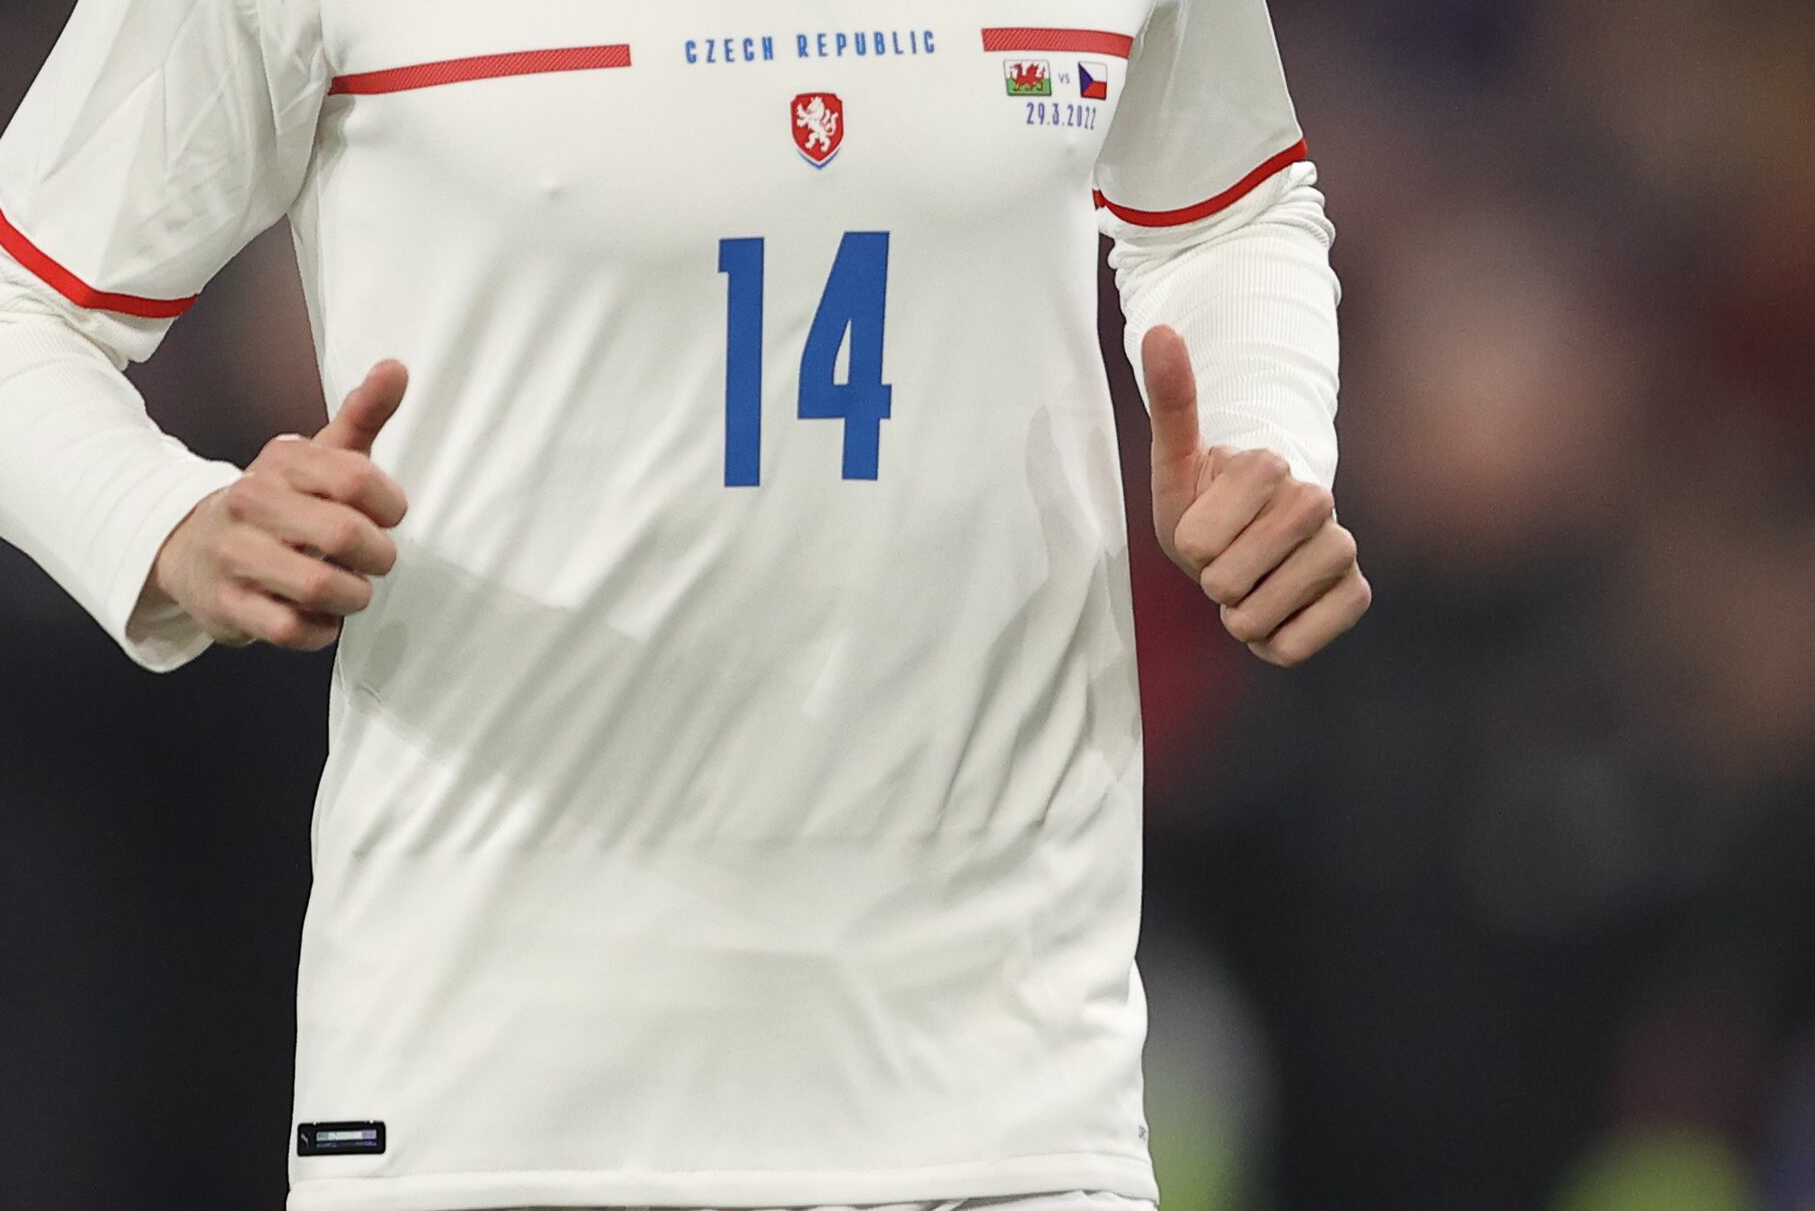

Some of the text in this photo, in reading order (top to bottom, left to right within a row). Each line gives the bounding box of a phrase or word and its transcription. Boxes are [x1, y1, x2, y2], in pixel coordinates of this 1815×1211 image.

[684, 30, 936, 64] CZECH REPUBLIC
[717, 230, 892, 487] 14
